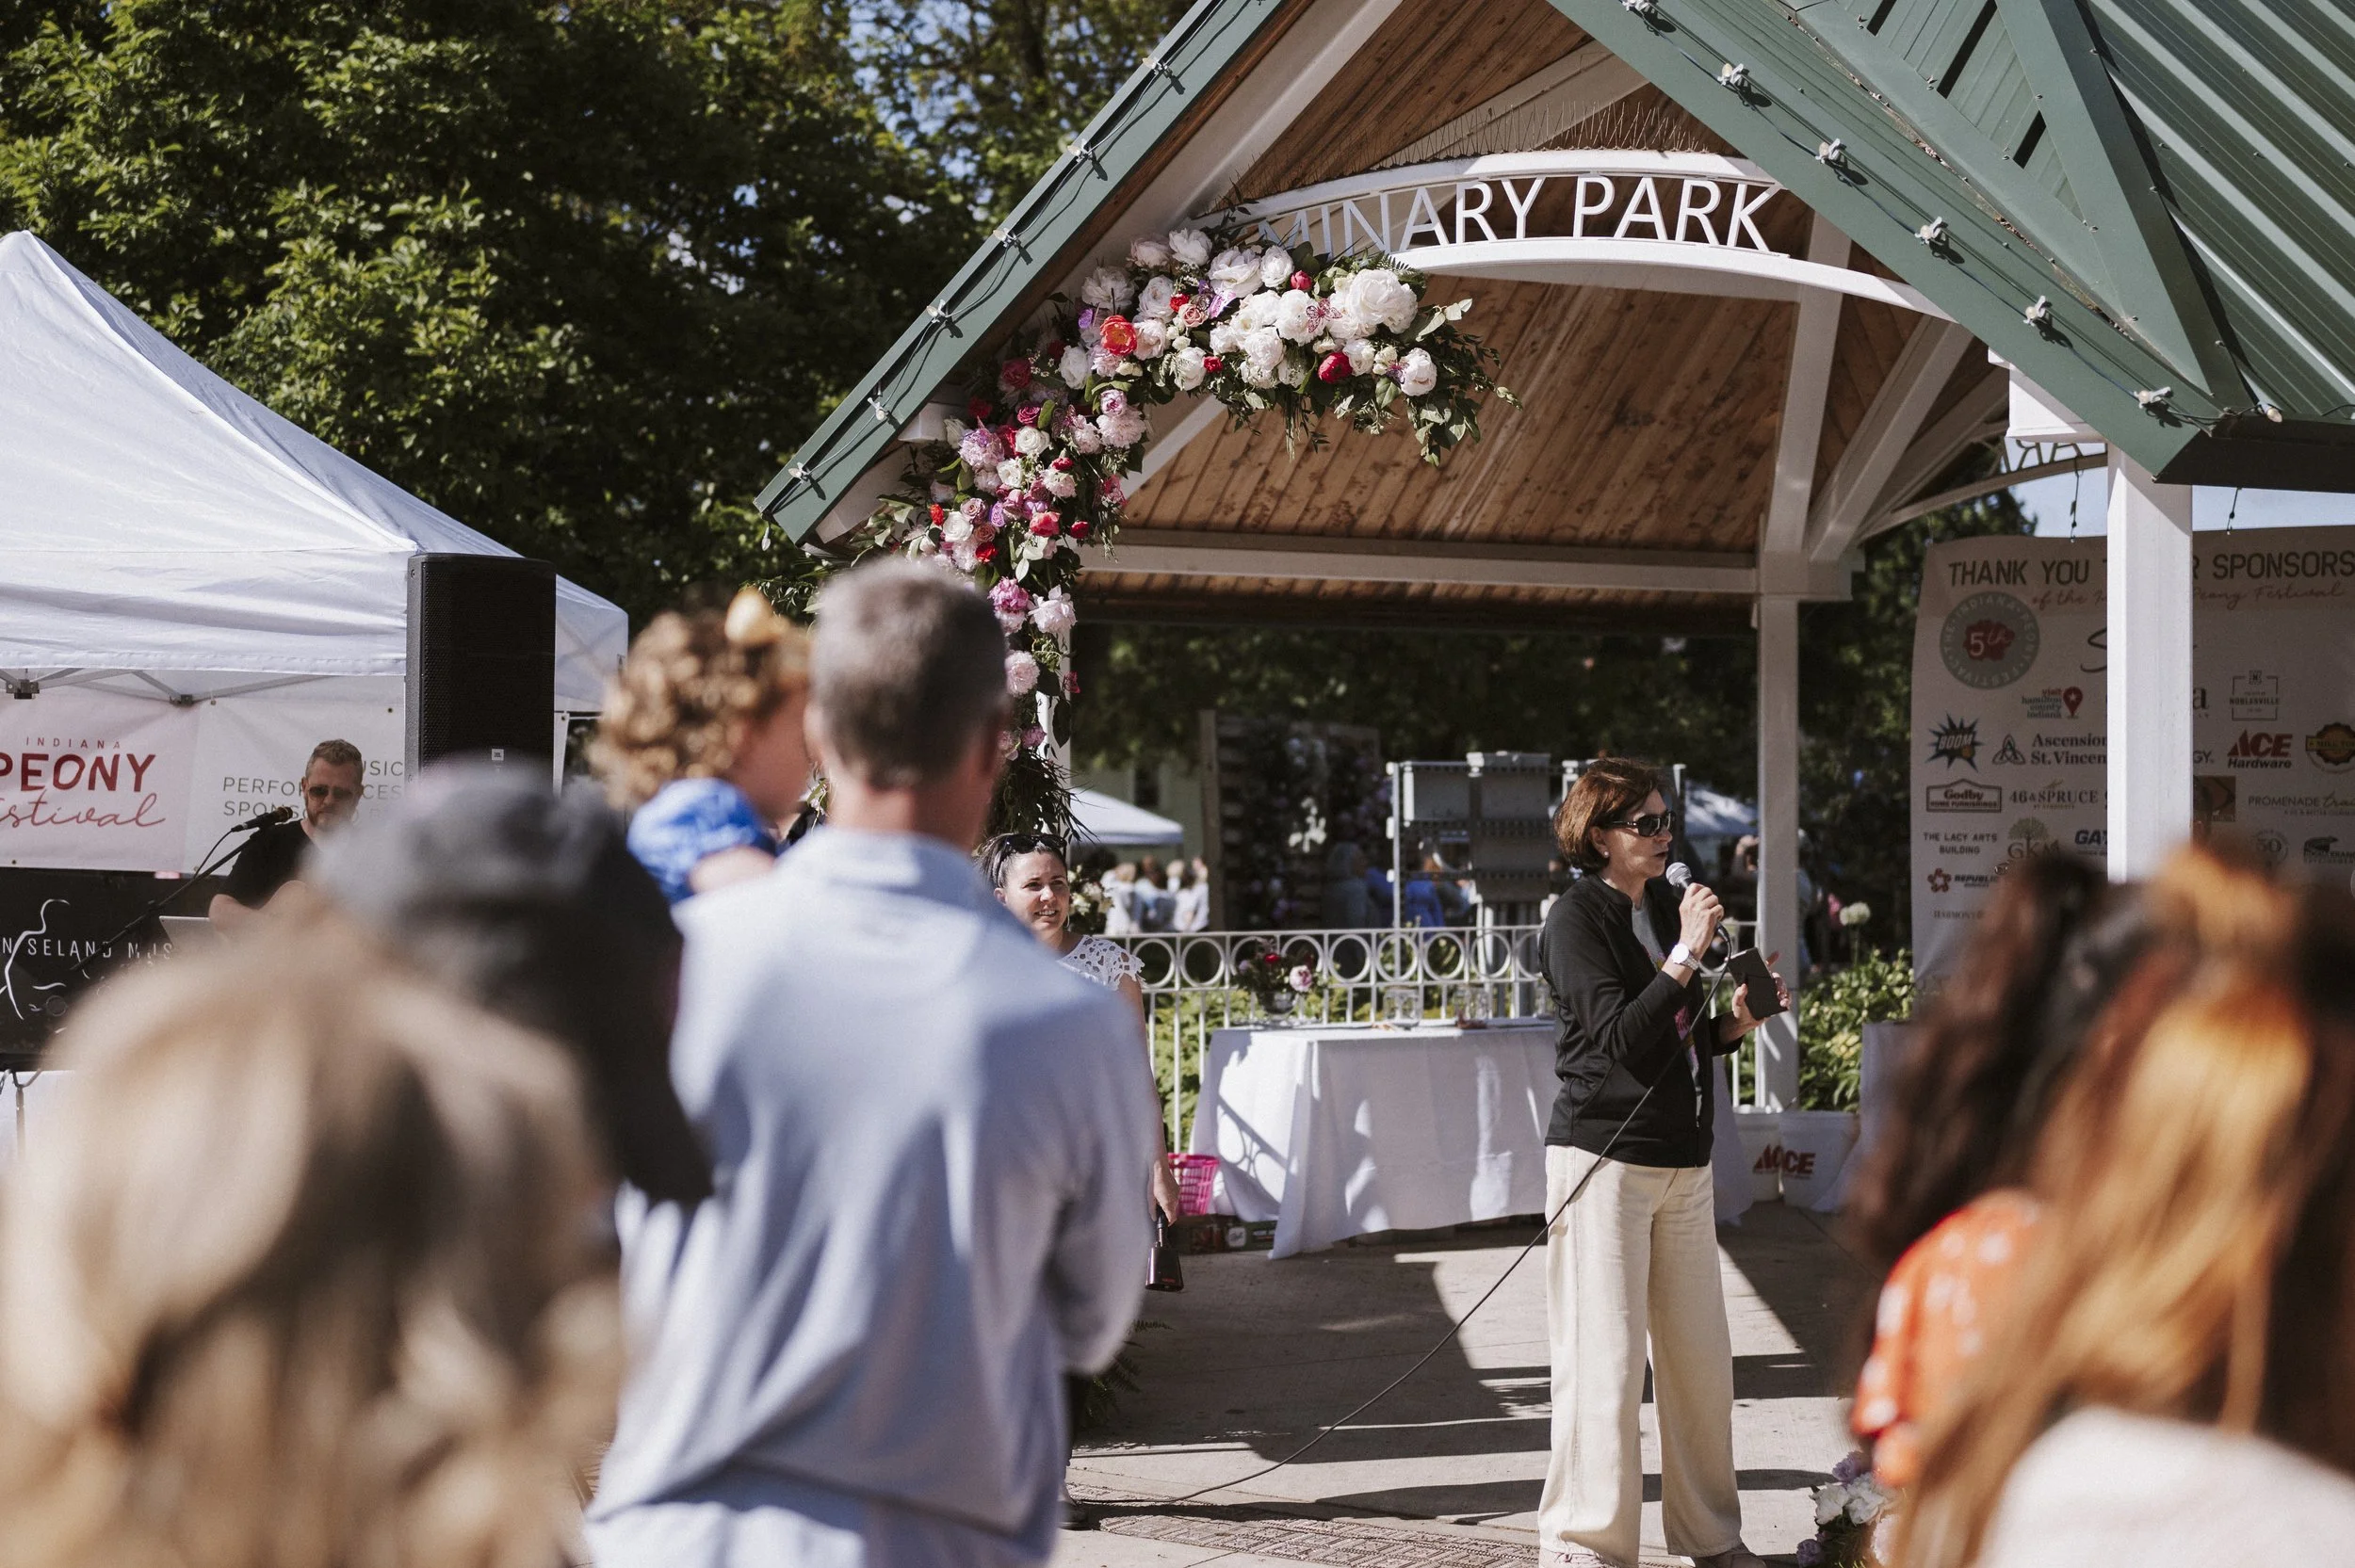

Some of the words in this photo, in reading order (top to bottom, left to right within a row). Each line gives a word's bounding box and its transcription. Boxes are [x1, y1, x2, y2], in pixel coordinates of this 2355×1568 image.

[1259, 176, 1546, 259] MINARY
[1572, 175, 1778, 252] PARK
[1949, 558, 2028, 587] THANK
[2041, 558, 2089, 586] YOU
[2213, 550, 2355, 580] SPONSORS
[2032, 590, 2052, 611] of
[2056, 588, 2087, 606] the
[2252, 581, 2345, 601] Festival
[25, 736, 121, 749] INDIANA
[2227, 729, 2293, 758] ACE
[2054, 751, 2107, 765] Vincen
[2227, 757, 2293, 768] Hardware
[1943, 788, 1984, 800] Godby
[2248, 796, 2320, 807] PROMENADE
[0, 789, 166, 828] stival
[1924, 832, 1941, 841] THE
[1944, 832, 1968, 842] LACY
[1973, 833, 1998, 842] ARTS
[1940, 845, 1980, 854] BUILDING
